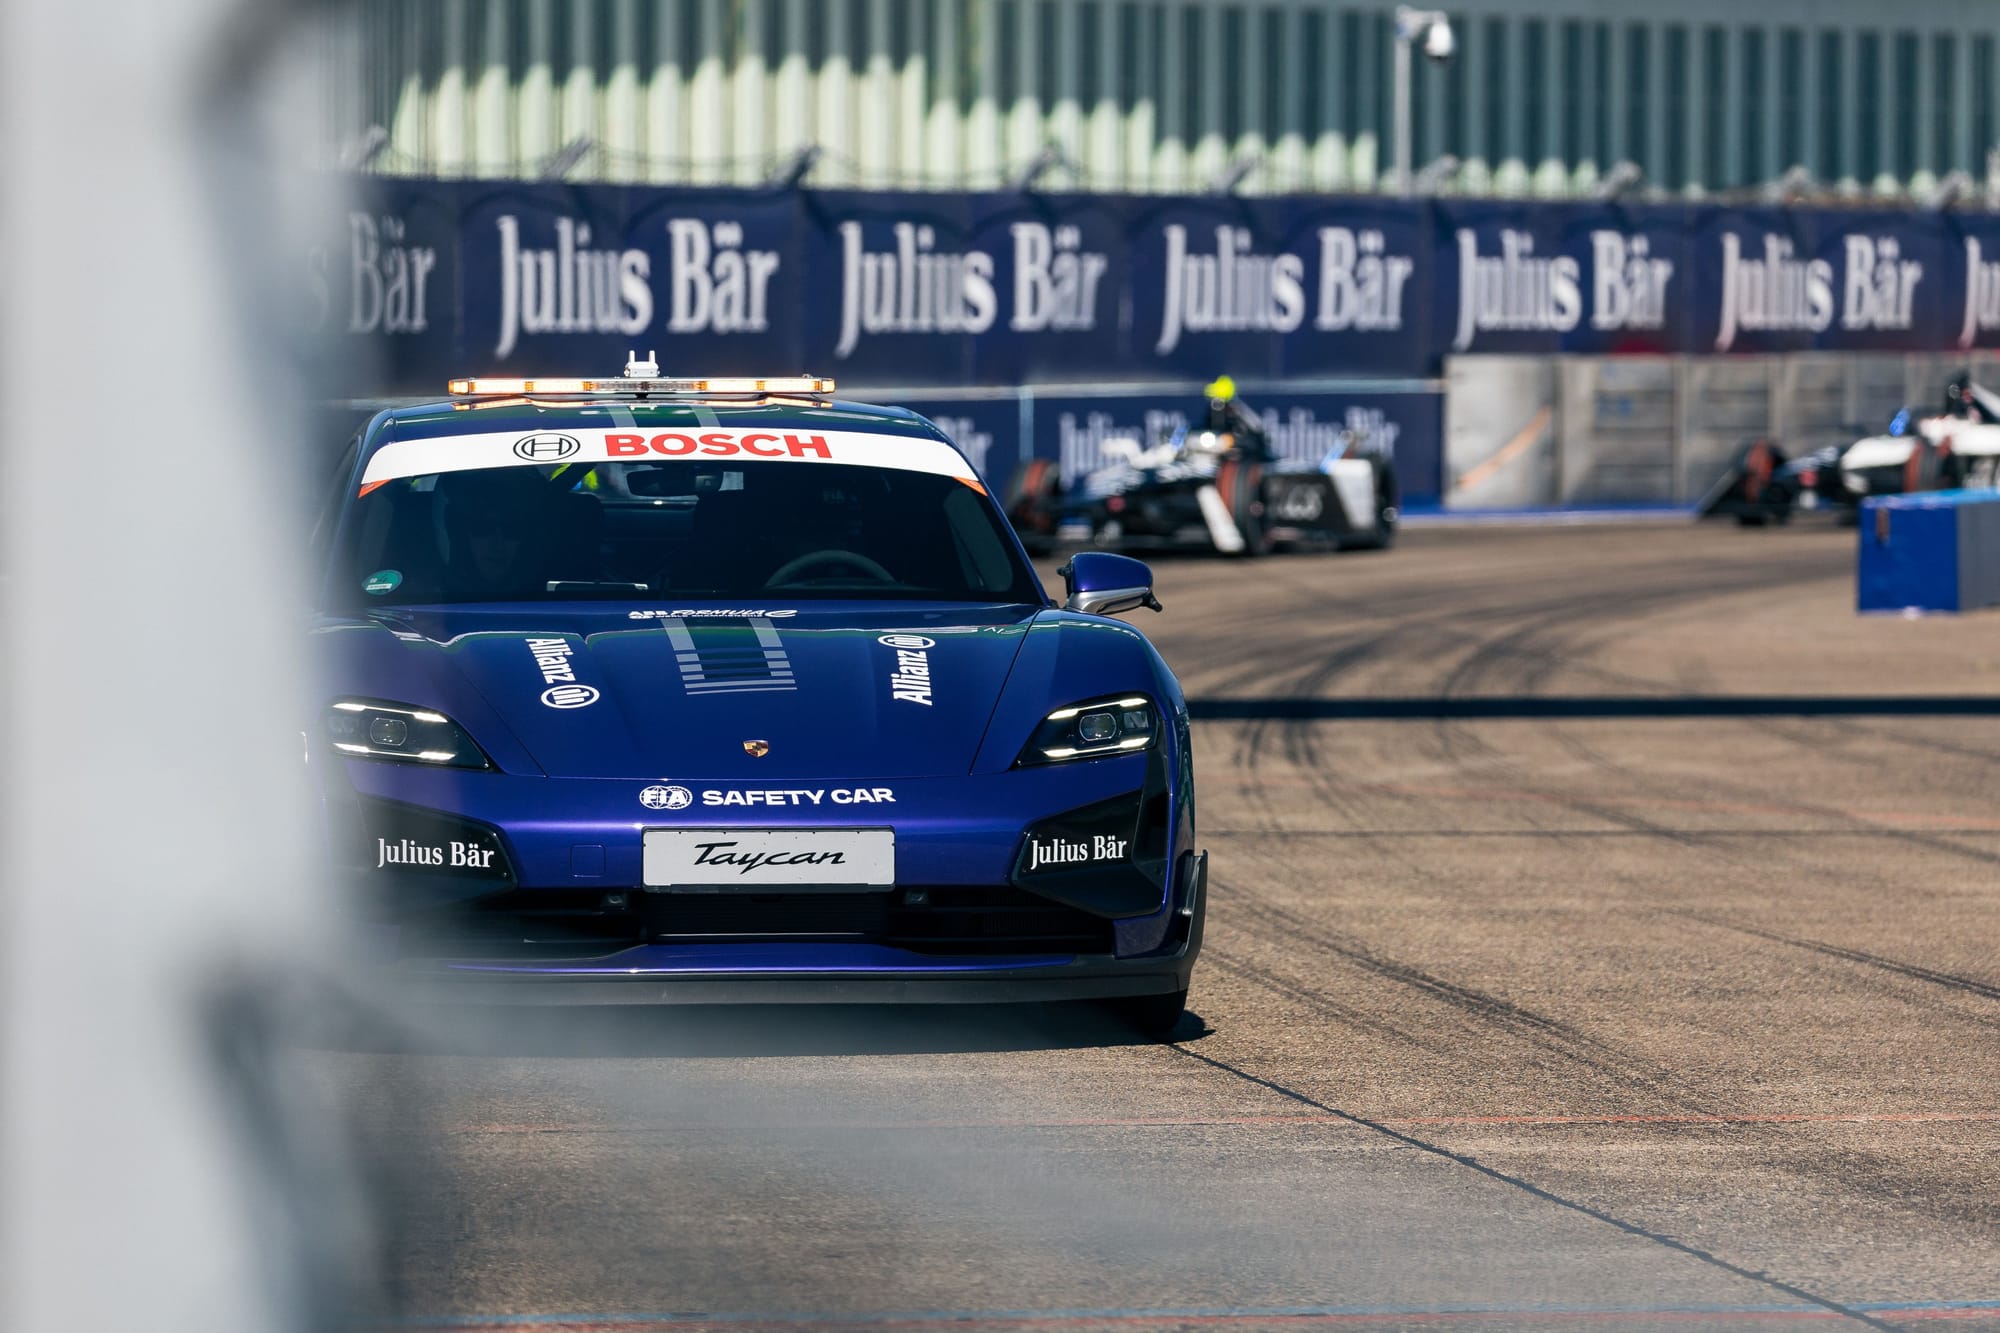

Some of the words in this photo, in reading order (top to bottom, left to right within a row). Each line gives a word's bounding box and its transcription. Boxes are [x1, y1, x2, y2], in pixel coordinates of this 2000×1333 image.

[495, 215, 654, 359] Julius
[667, 218, 779, 334] Bär
[835, 221, 997, 359] Julius
[1009, 222, 1108, 332] Bär
[1156, 224, 1305, 355] Julius
[1314, 226, 1413, 332] Bär
[1453, 228, 1582, 352] Julius
[1590, 230, 1673, 331] Bär
[1714, 231, 1834, 351] Julius
[1841, 234, 1923, 331] Bär
[605, 433, 832, 458] BOSCH
[525, 638, 576, 684] Allianz
[891, 649, 932, 706] Allianz
[642, 788, 689, 805] FIA
[702, 790, 824, 806] SAFETY
[830, 788, 897, 804] CAR
[377, 838, 443, 868] Julius
[449, 841, 495, 868] Bär
[694, 841, 846, 875] Taycan
[1030, 838, 1088, 870] Julius
[1093, 835, 1128, 860] Bär
